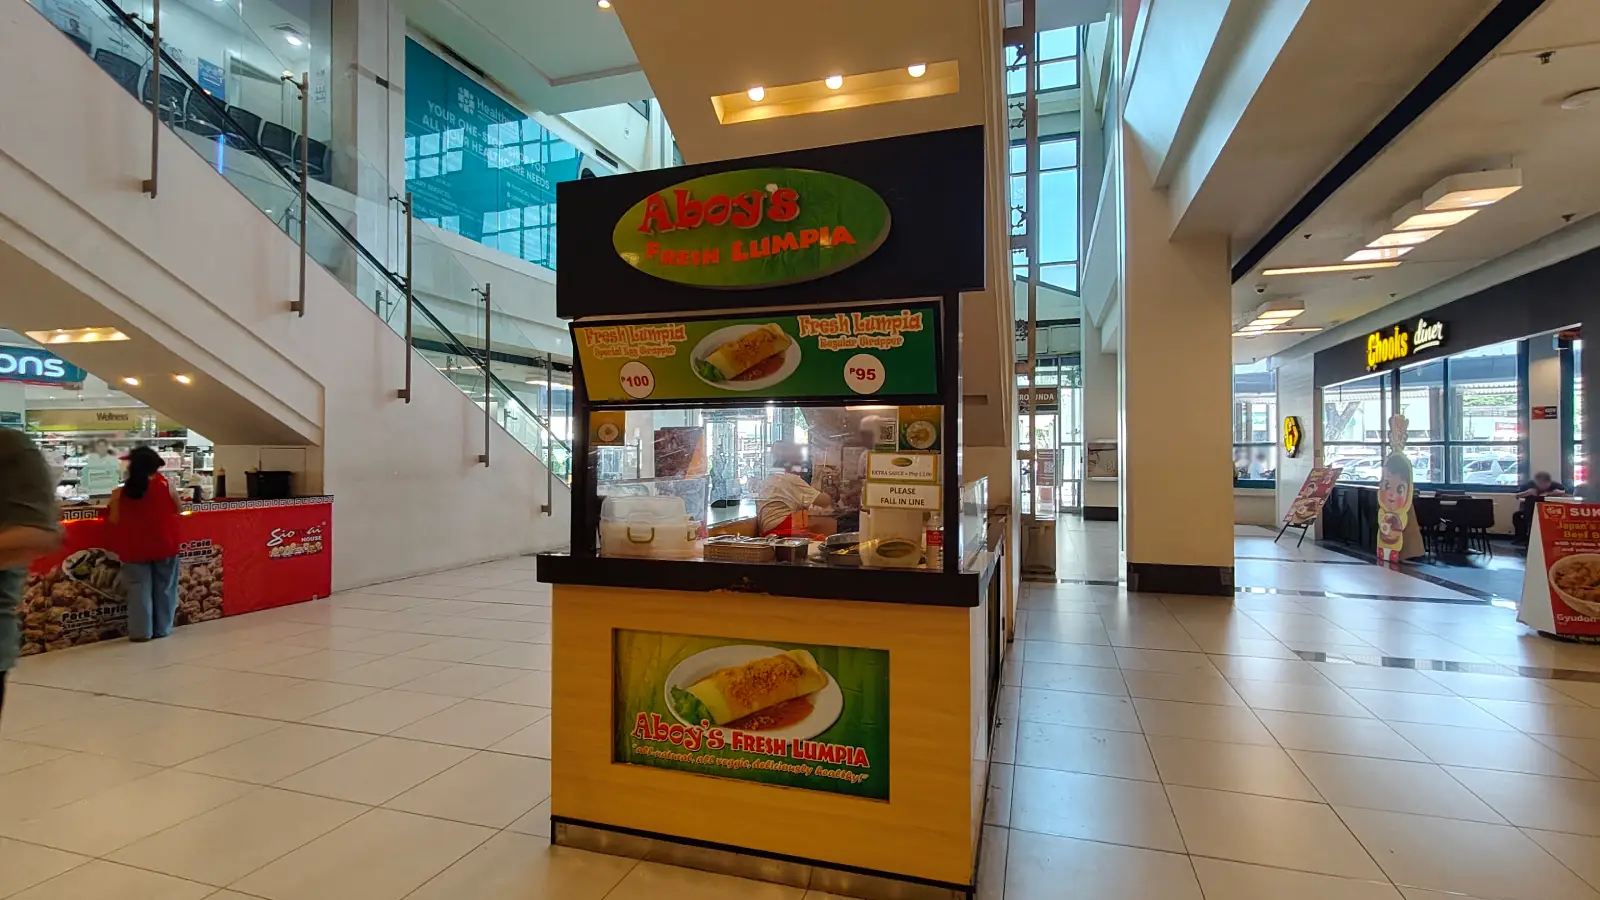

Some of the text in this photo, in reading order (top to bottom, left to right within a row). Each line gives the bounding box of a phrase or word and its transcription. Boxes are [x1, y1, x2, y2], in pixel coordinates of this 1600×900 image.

[428, 100, 456, 125] YOUR
[422, 114, 440, 132] ALL
[526, 168, 550, 190] NEEDS
[637, 182, 801, 235] Aboy's
[731, 225, 856, 263] LUMPIA
[585, 323, 687, 347] Fresh Lumpia
[797, 310, 923, 337] Fresh Lumpia
[819, 335, 904, 350] Regular Wrapper
[1367, 318, 1444, 367] Chooks diner
[1019, 393, 1055, 401] ROUNDA
[96, 412, 129, 422] Wellness
[880, 497, 897, 505] FALL
[908, 498, 925, 506] LINE
[889, 487, 916, 495] PLEASE
[300, 535, 322, 543] HOUSE
[1557, 613, 1597, 624] Gyudon
[631, 711, 870, 768] Aboy's FRESH LUMPIA
[696, 753, 715, 765] all
[752, 759, 813, 776] deliciously
